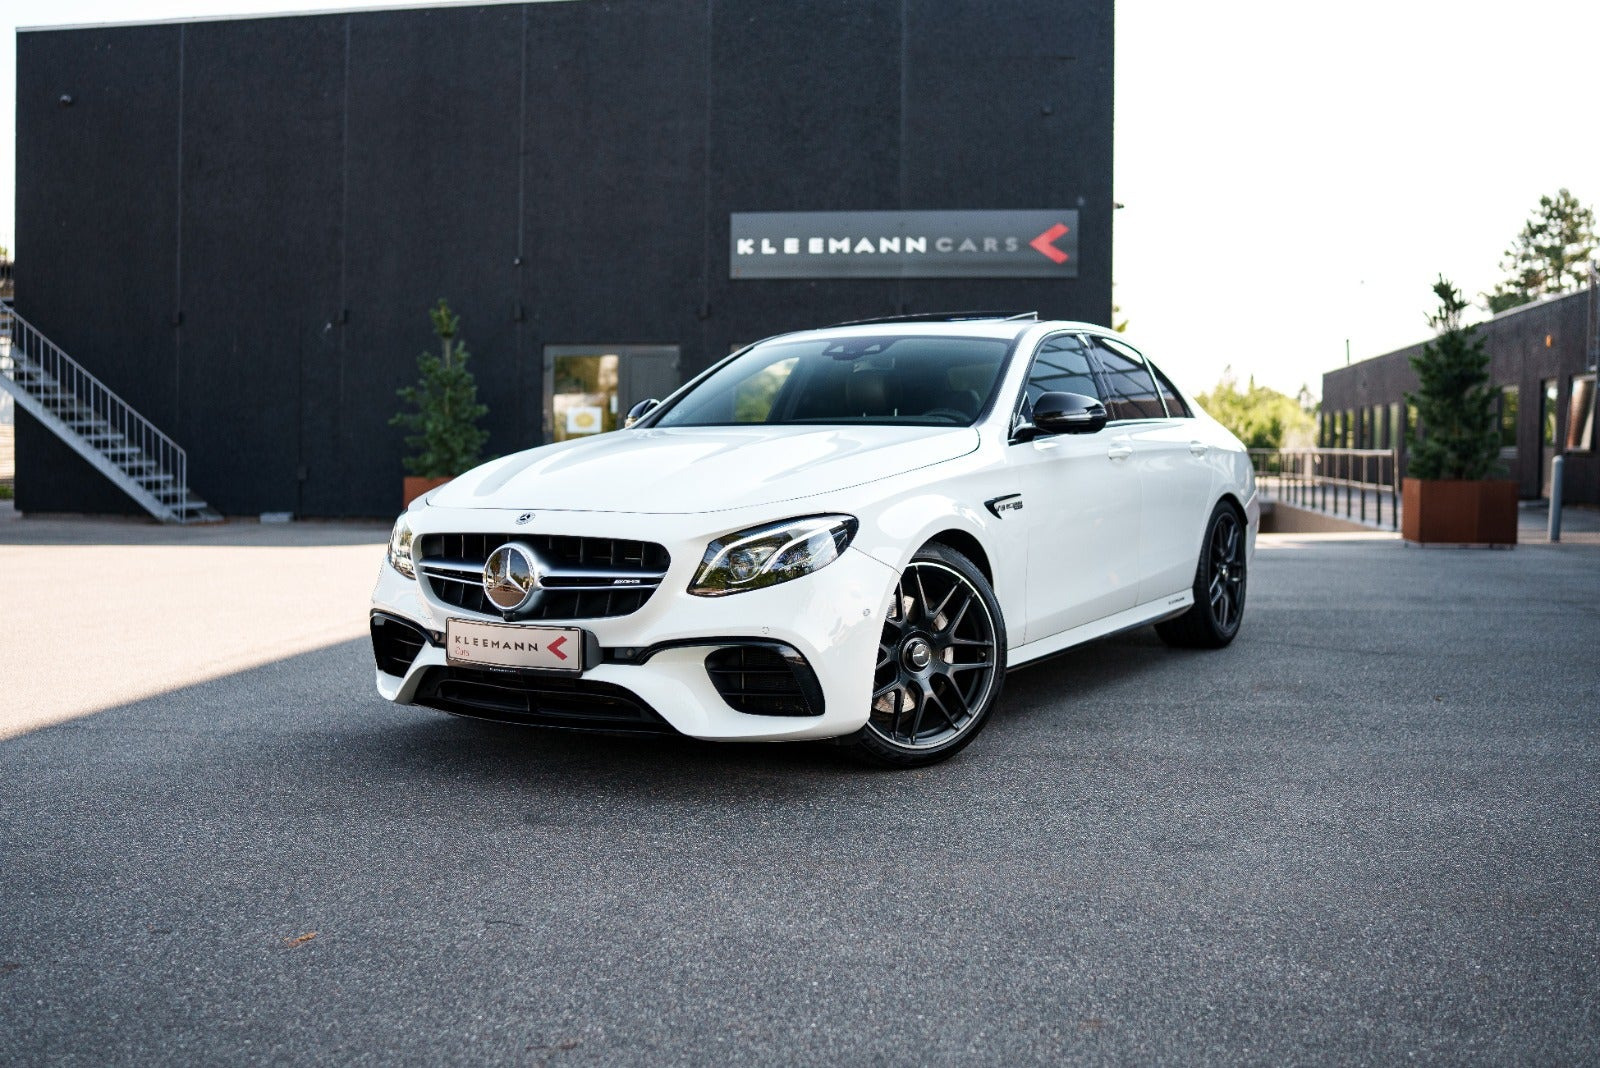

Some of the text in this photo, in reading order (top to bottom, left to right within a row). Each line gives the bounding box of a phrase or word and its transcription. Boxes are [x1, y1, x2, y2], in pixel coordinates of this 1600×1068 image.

[737, 236, 1019, 255] KLEEMANN CARS
[455, 635, 538, 652] KLEEMANN
